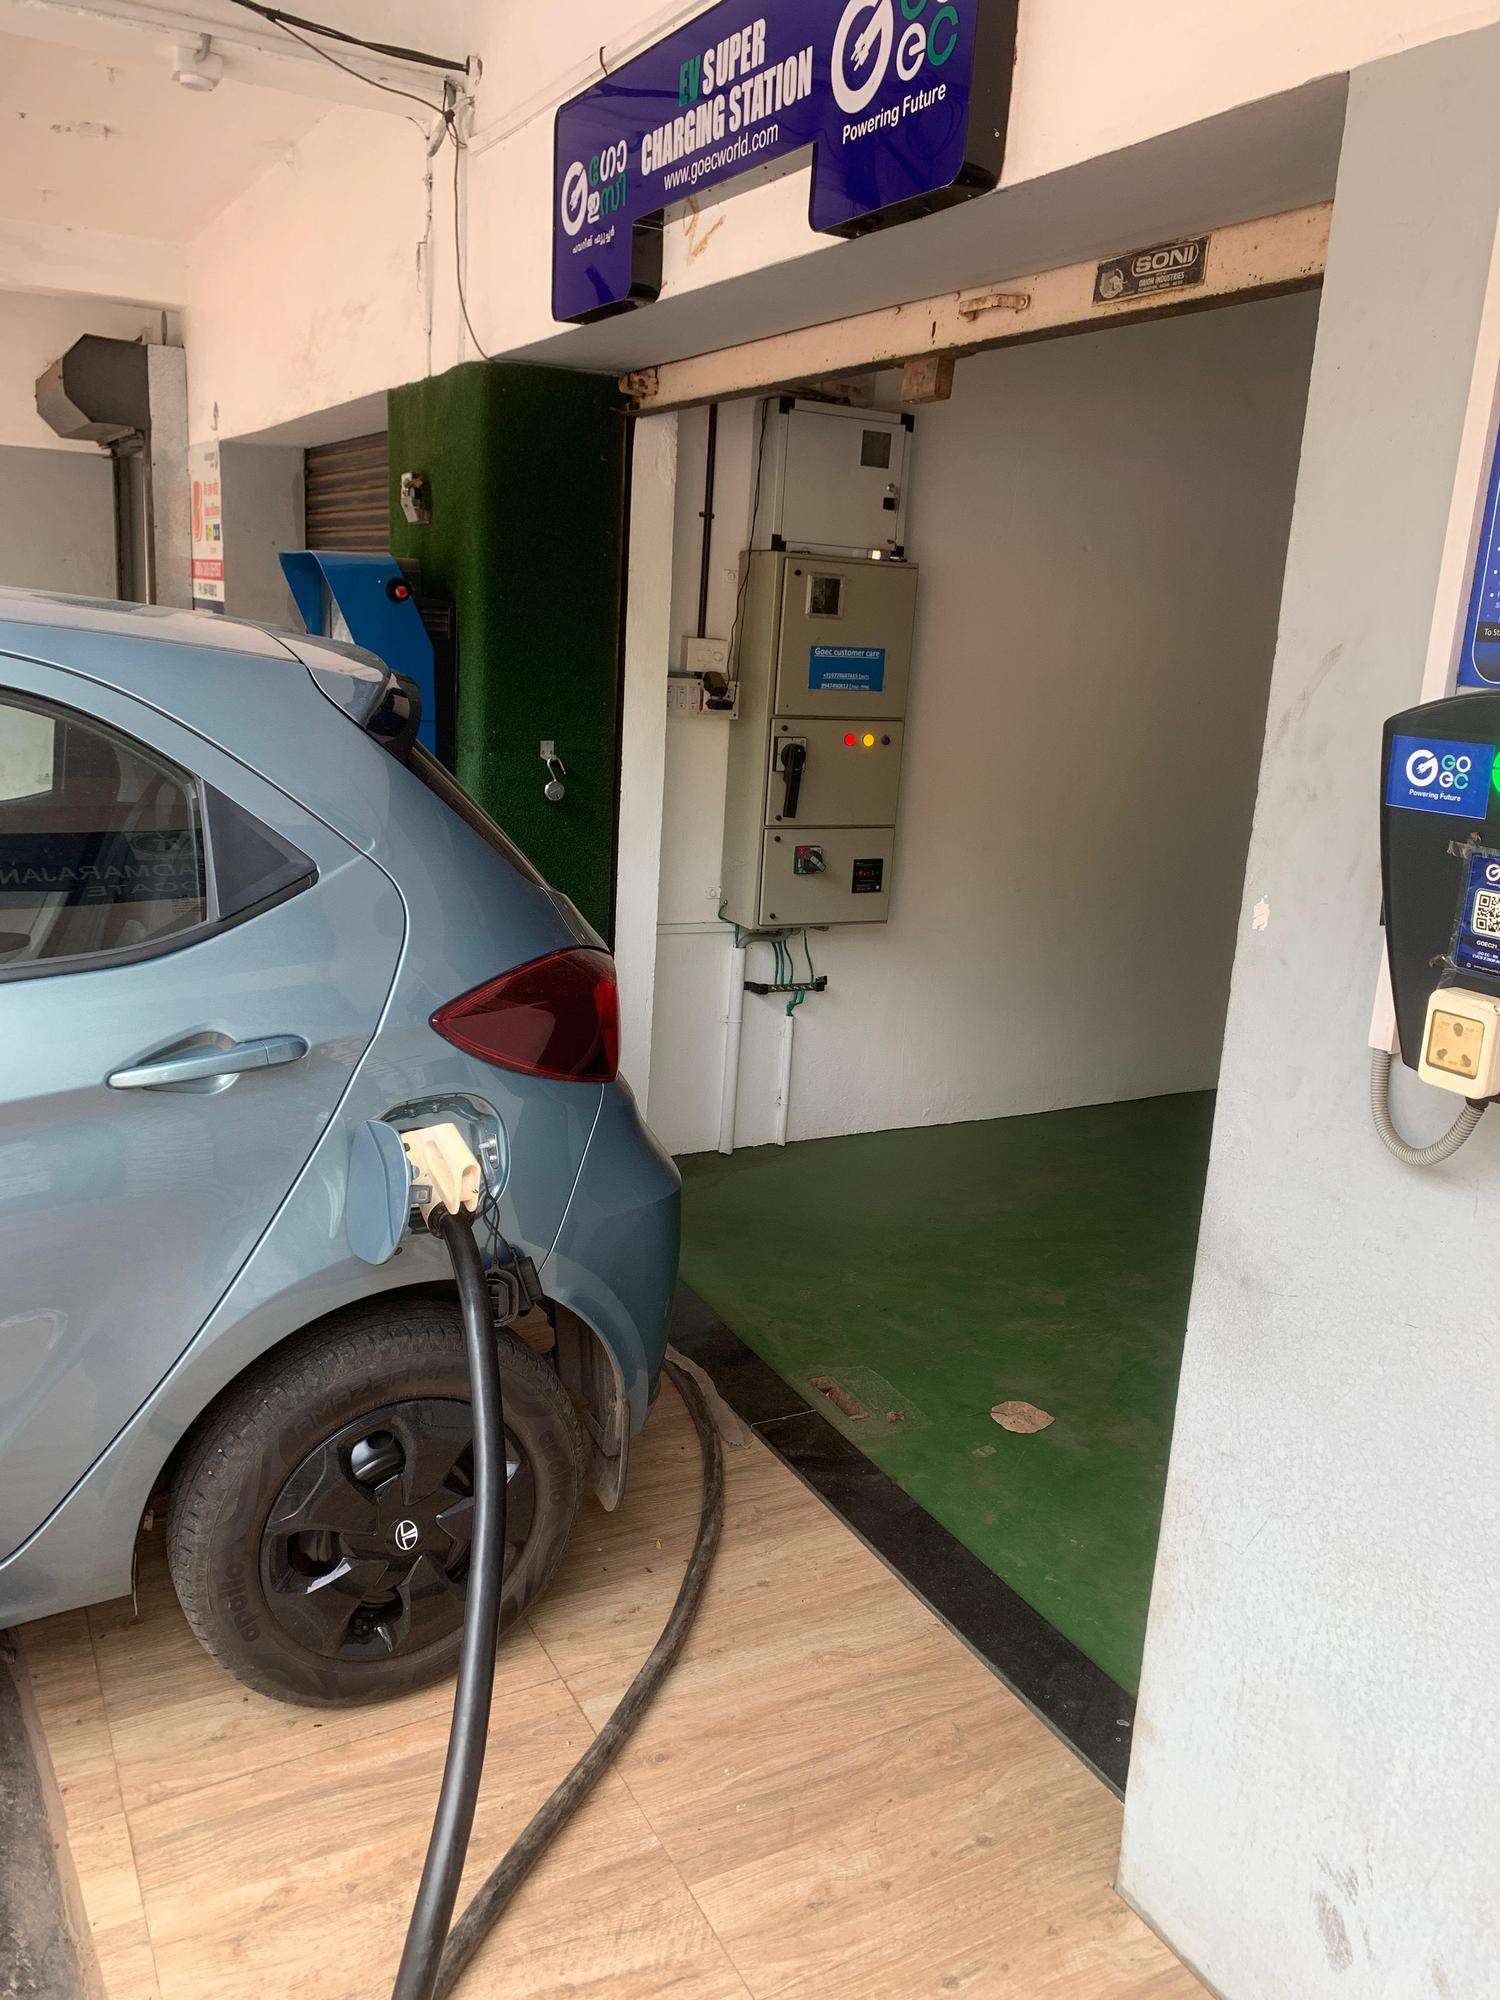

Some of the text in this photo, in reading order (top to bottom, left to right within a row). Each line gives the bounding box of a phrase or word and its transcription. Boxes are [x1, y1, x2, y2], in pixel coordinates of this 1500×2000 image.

[679, 18, 766, 107] EV SUPER
[641, 45, 813, 176] CHARGING STATION
[842, 83, 947, 145] Powering Future
[663, 123, 779, 191] www.goecworld.com
[1135, 245, 1195, 273] SONI
[814, 647, 832, 656] Goec
[833, 648, 865, 657] customer
[1409, 788, 1461, 802] Powering Future
